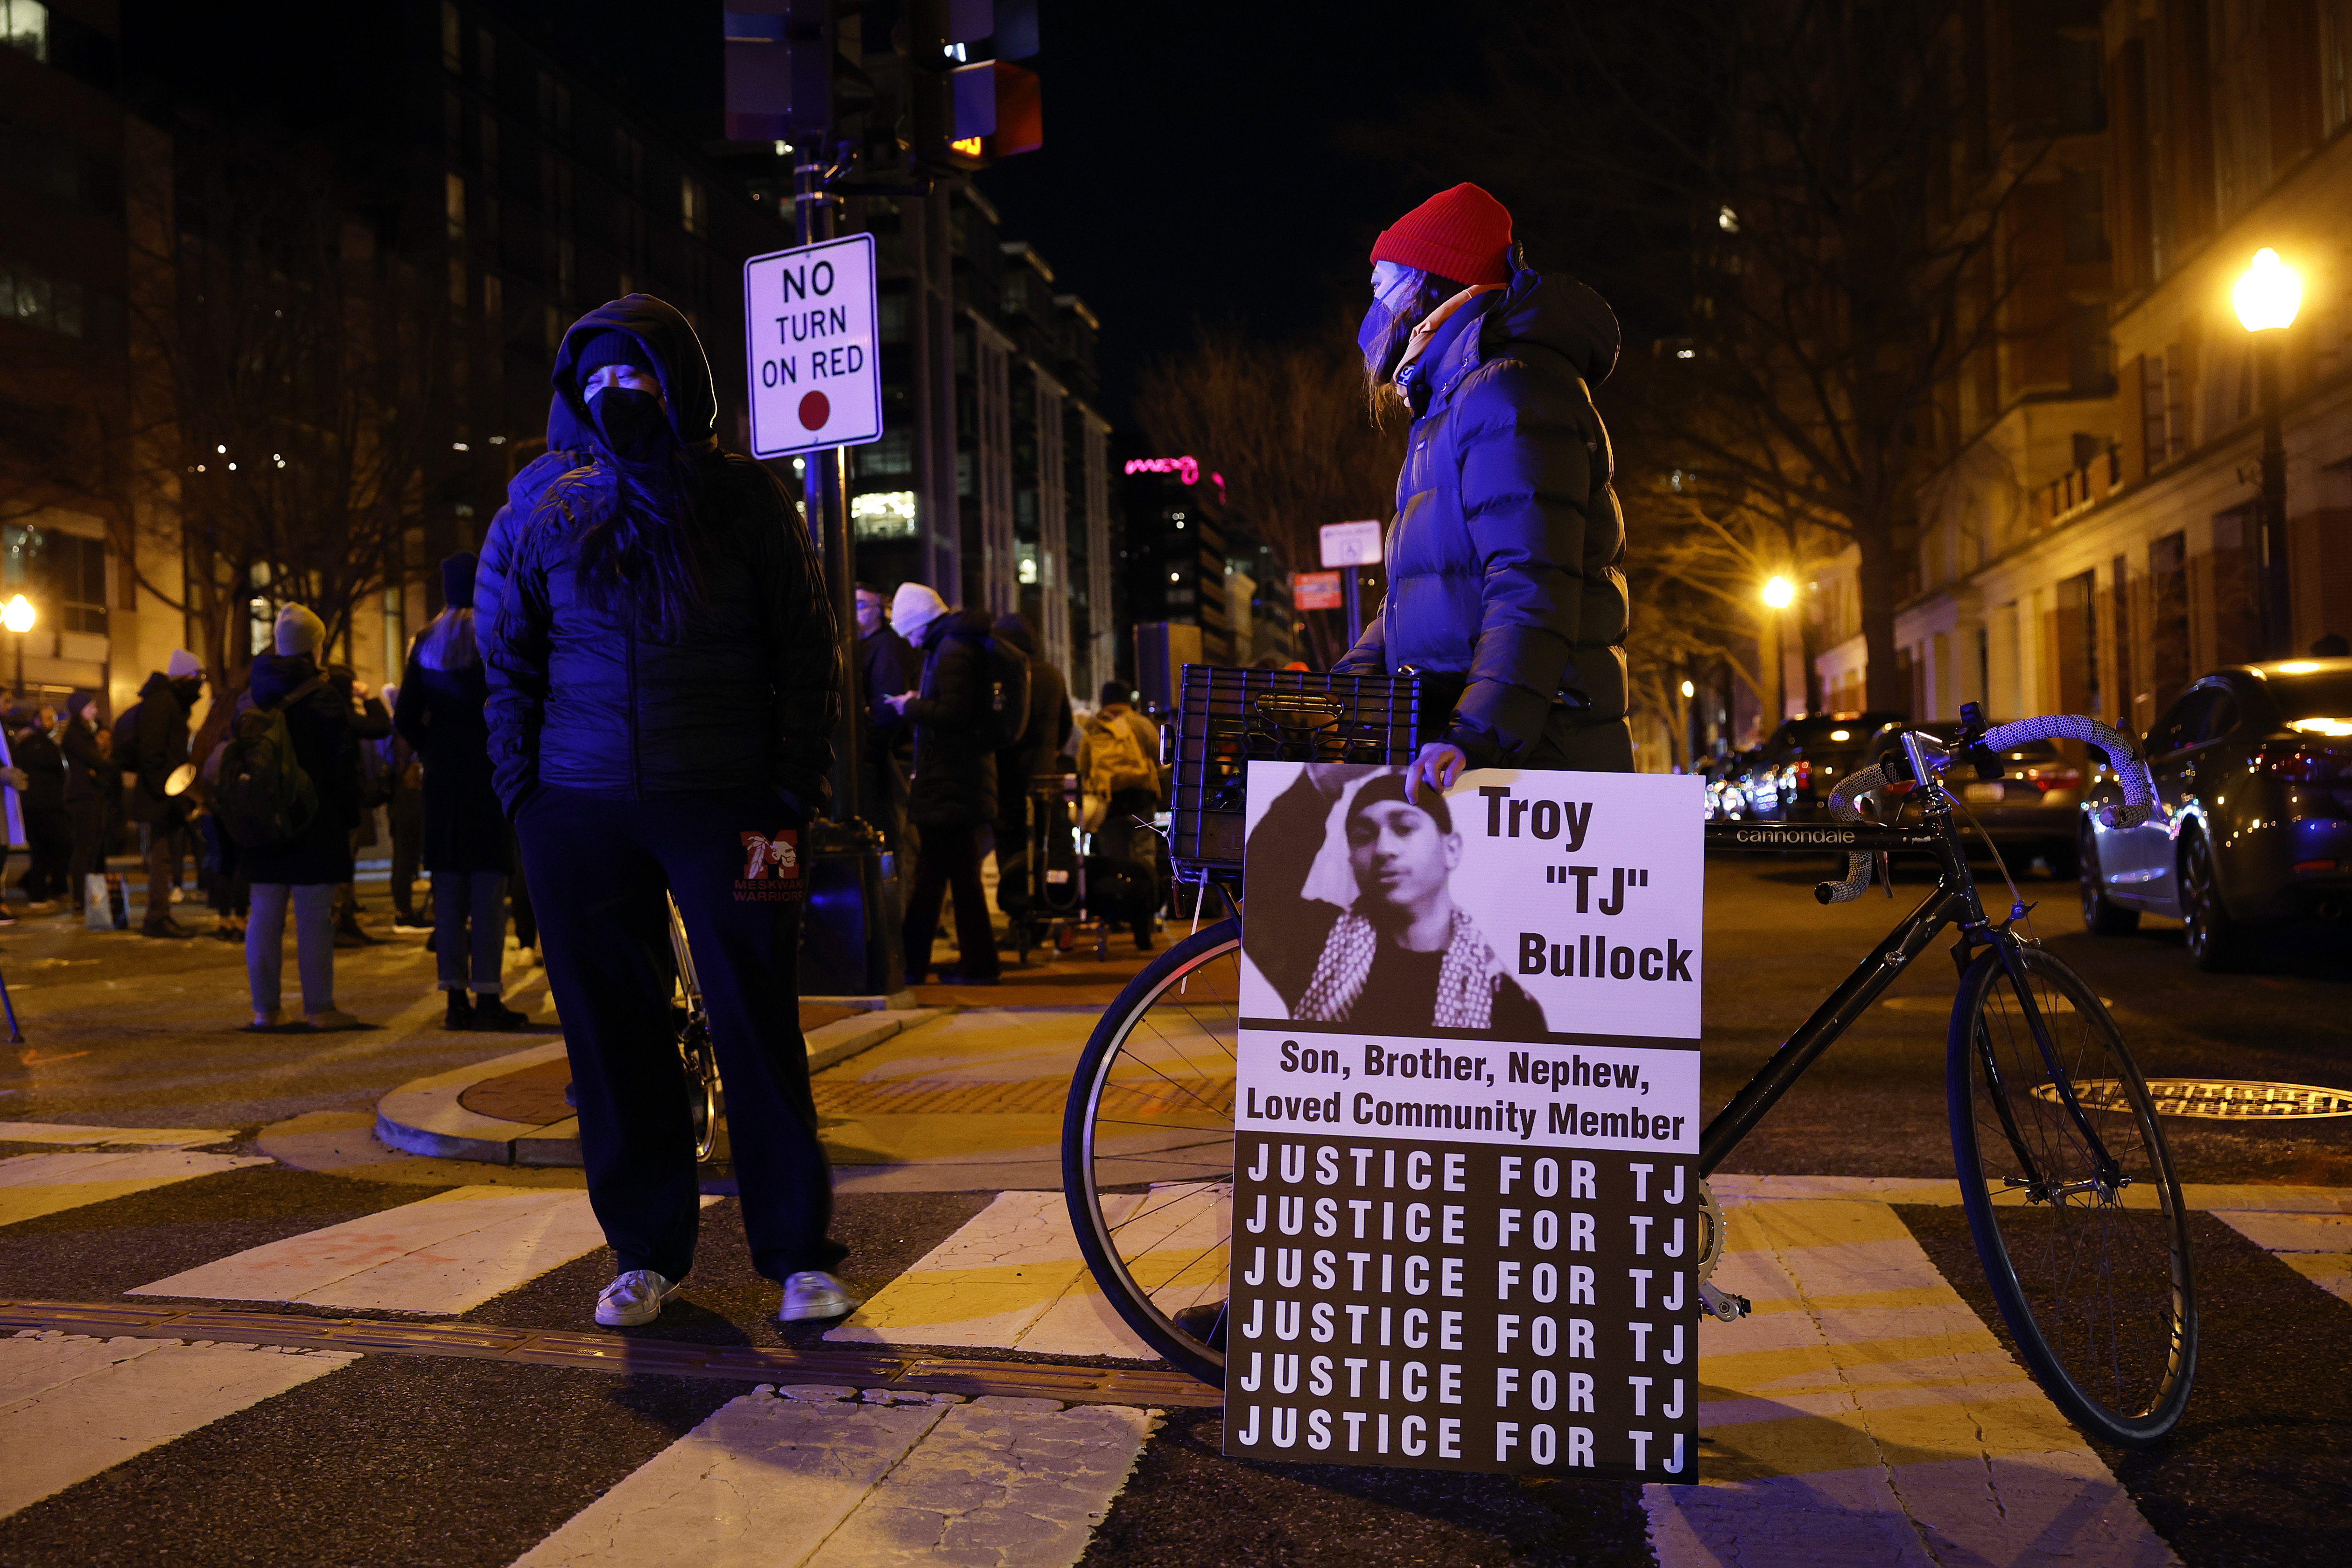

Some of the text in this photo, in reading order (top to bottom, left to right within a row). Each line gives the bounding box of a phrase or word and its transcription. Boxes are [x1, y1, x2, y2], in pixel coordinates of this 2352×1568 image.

[783, 260, 834, 303] NO
[776, 305, 847, 345] TURN
[762, 345, 864, 388] ON RED
[1479, 786, 1593, 852] Troy
[1736, 828, 1855, 843] cannondale
[1546, 865, 1648, 916] "TJ"
[1518, 932, 1693, 982] Bullock
[1280, 1040, 1649, 1096] Son, Brother, Nephew,
[1247, 1087, 1685, 1140] Loved Community Member
[1248, 1143, 1684, 1204] JUSTICE FOR TJ
[1246, 1195, 1684, 1257] JUSTICE FOR TJ
[1244, 1246, 1684, 1311] JUSTICE FOR TJ
[1243, 1299, 1684, 1364] JUSTICE FOR TJ
[1241, 1352, 1684, 1419] JUSTICE FOR TJ
[1239, 1406, 1684, 1473] JUSTICE FOR TJ
